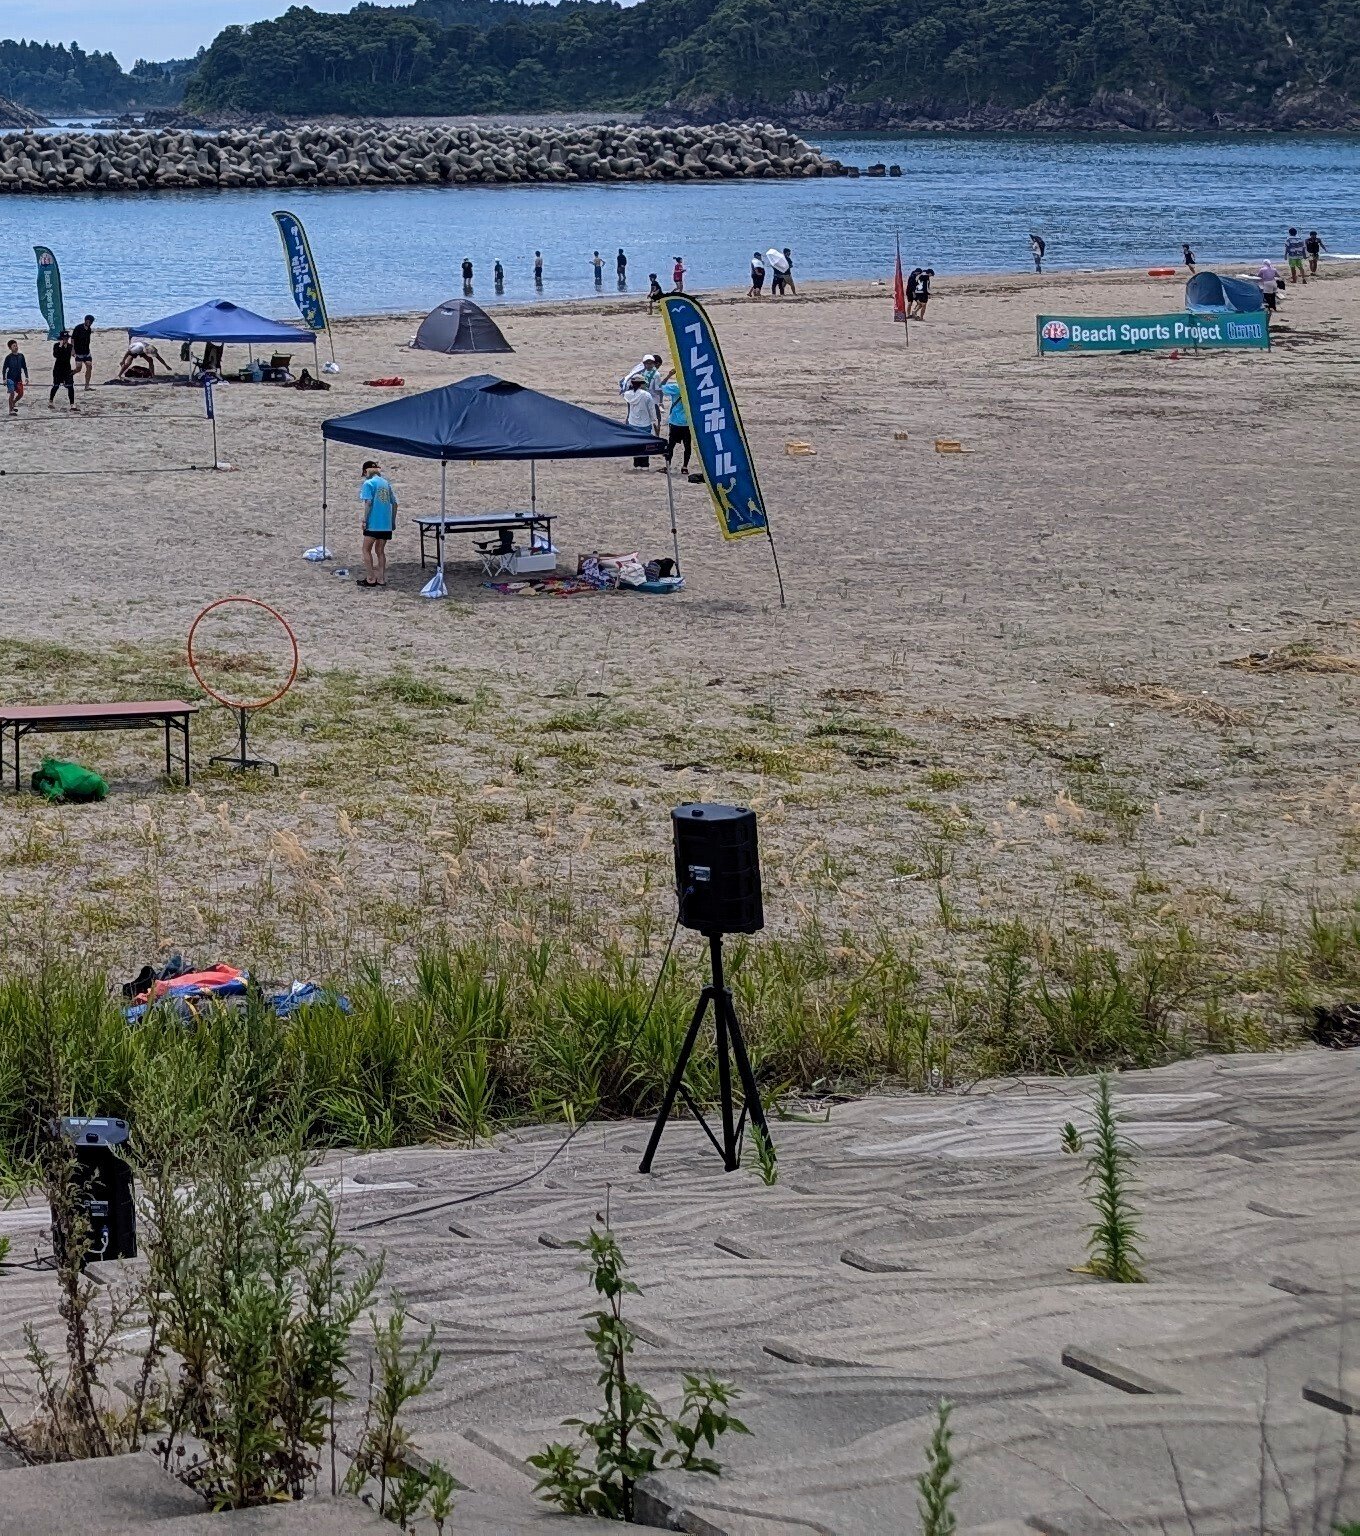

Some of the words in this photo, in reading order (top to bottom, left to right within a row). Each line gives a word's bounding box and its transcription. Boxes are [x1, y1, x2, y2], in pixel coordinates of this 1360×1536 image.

[1072, 325, 1116, 341] Beach
[1120, 323, 1170, 344] Sports
[1174, 322, 1222, 343] Project
[684, 322, 737, 477] フレスコボール
